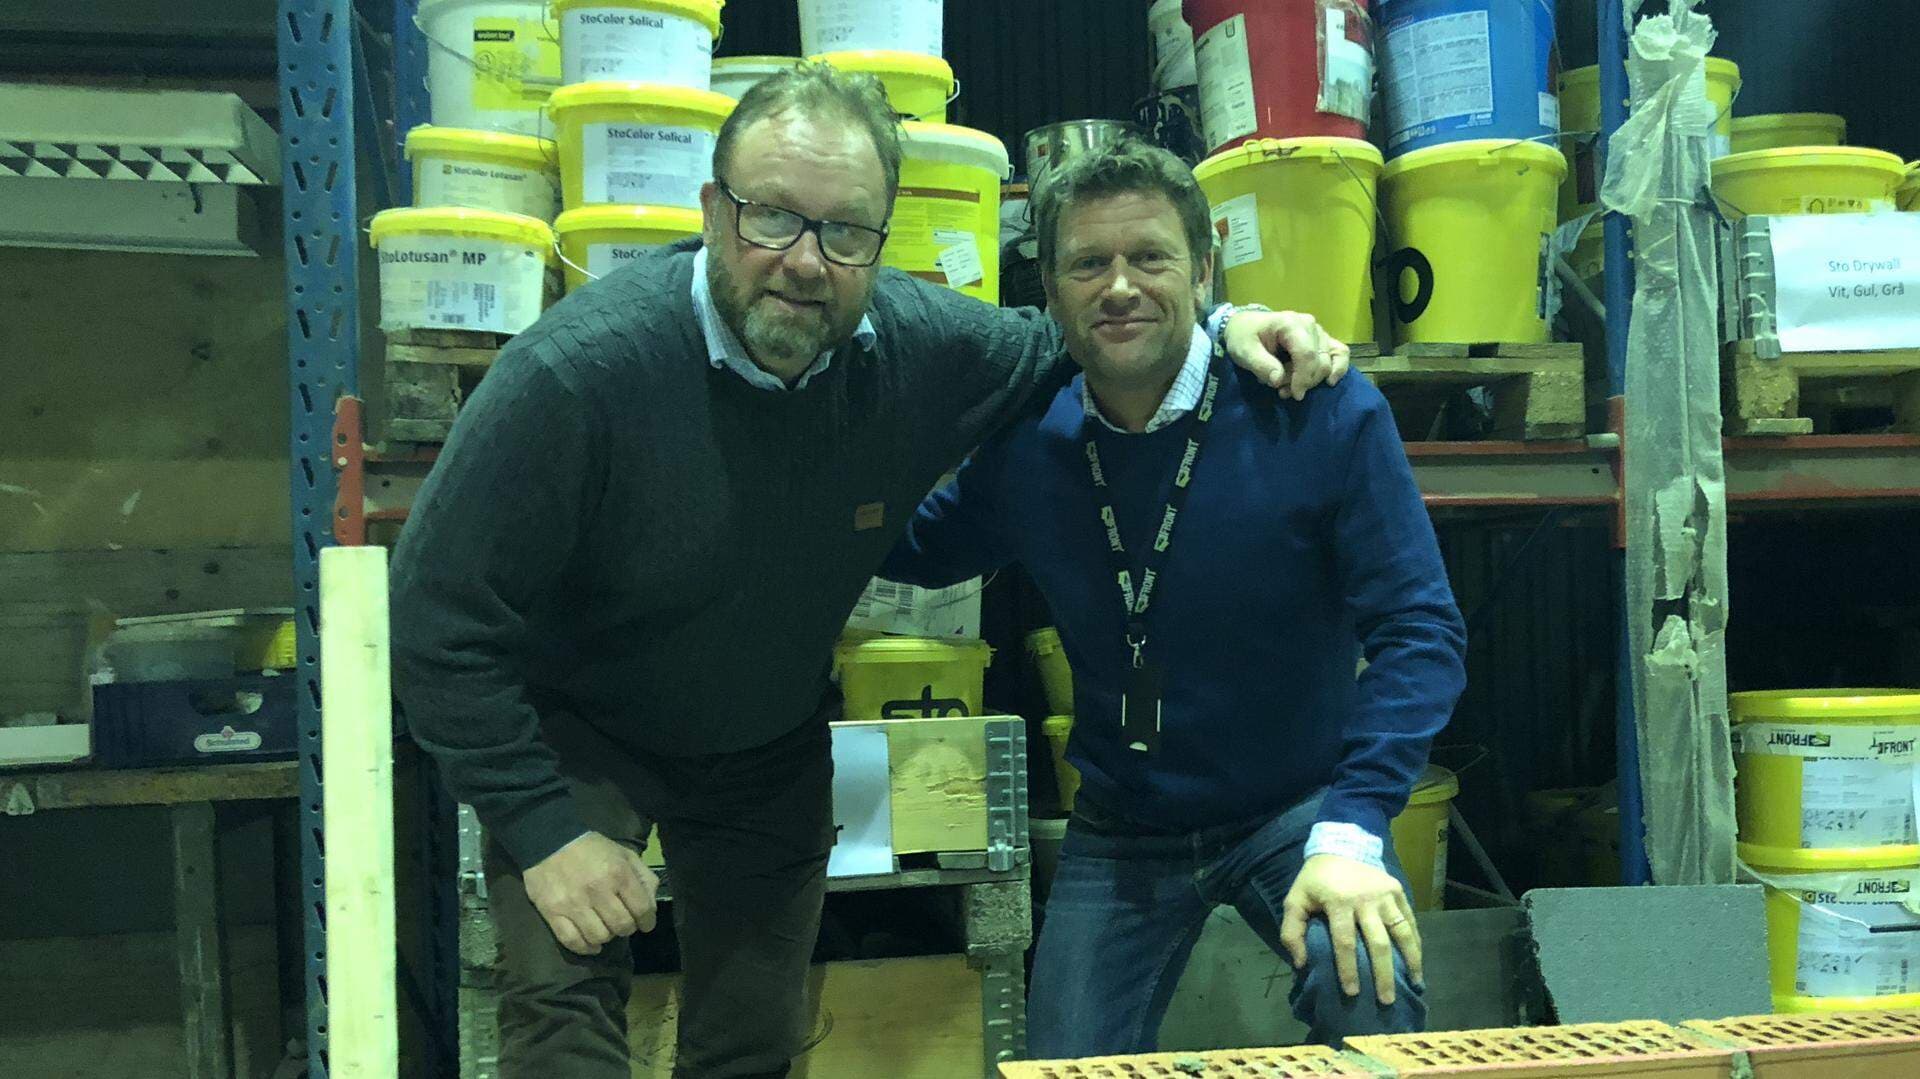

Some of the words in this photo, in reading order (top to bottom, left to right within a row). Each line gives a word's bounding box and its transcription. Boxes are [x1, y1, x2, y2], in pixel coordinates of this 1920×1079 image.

[580, 13, 626, 25] StoColor
[628, 15, 664, 29] Solical
[607, 127, 655, 140] StoColor
[657, 130, 692, 144] Solical
[462, 251, 487, 265] MP
[1828, 260, 1850, 272] Sto
[1852, 257, 1901, 274] Drywall
[1853, 283, 1878, 298] Gul,
